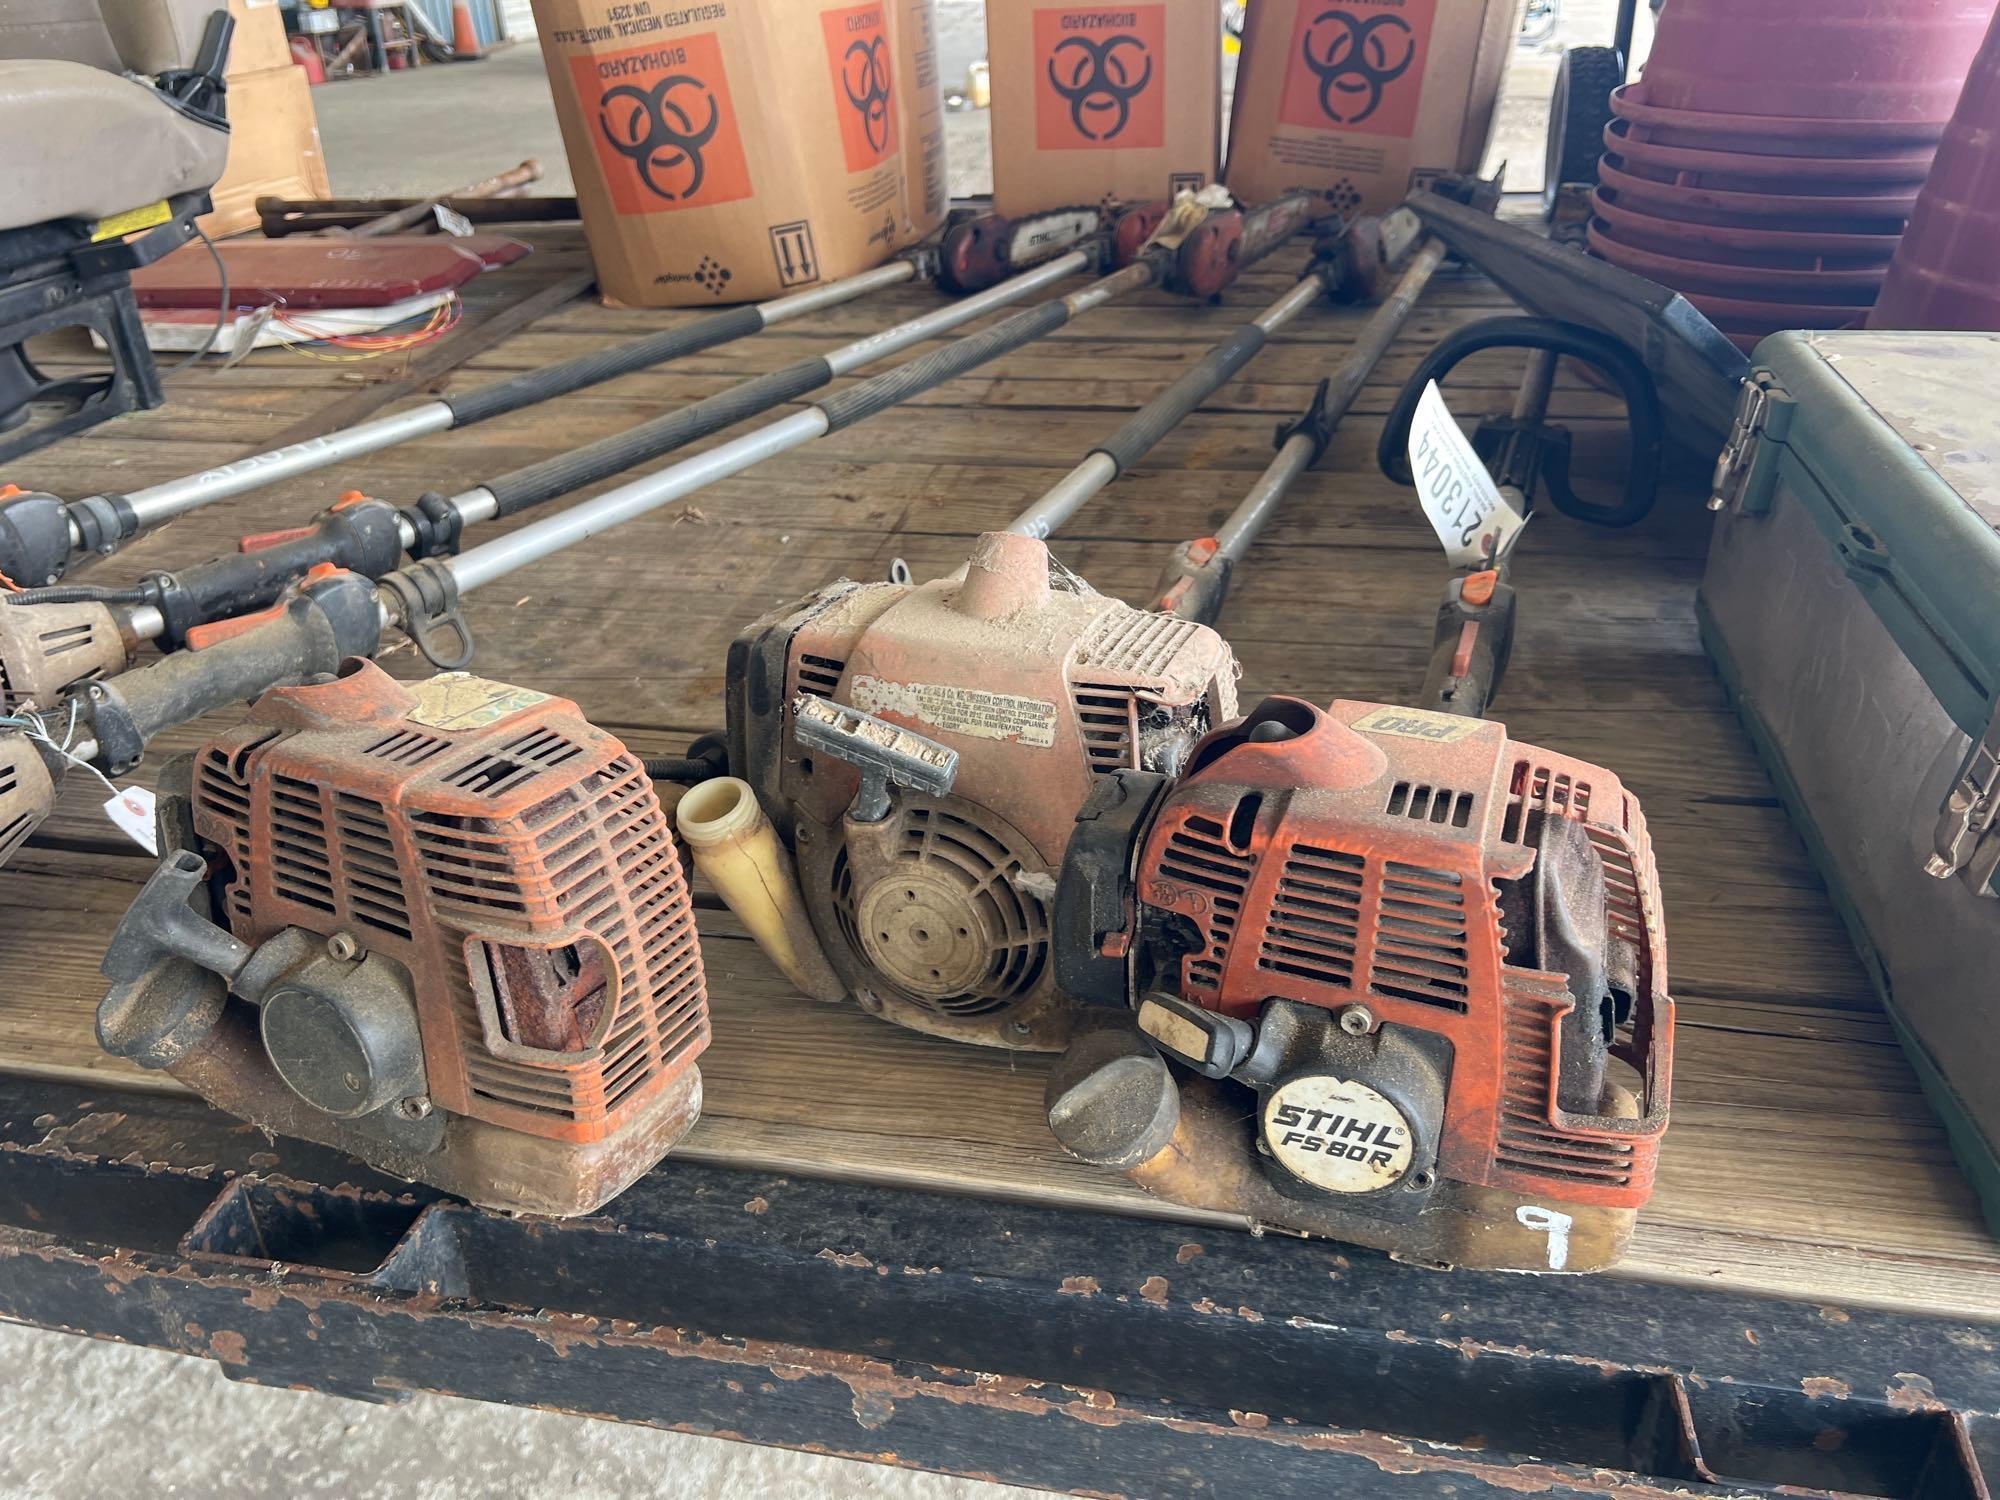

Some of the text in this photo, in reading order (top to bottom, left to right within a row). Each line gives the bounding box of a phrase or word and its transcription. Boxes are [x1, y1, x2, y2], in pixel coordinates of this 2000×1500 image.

[607, 4, 633, 21] 3291
[664, 3, 726, 27] REGULATED
[1060, 12, 1138, 30] BIOHAZARD
[616, 15, 663, 37] MEDICAL
[598, 48, 687, 79] BIOHAZARD
[1416, 430, 1483, 548] 213044
[992, 697, 1016, 708] CONTROL
[1018, 700, 1054, 713] INFORMATION
[1013, 717, 1049, 730] COMPLIANCE
[1372, 716, 1457, 738] PRO
